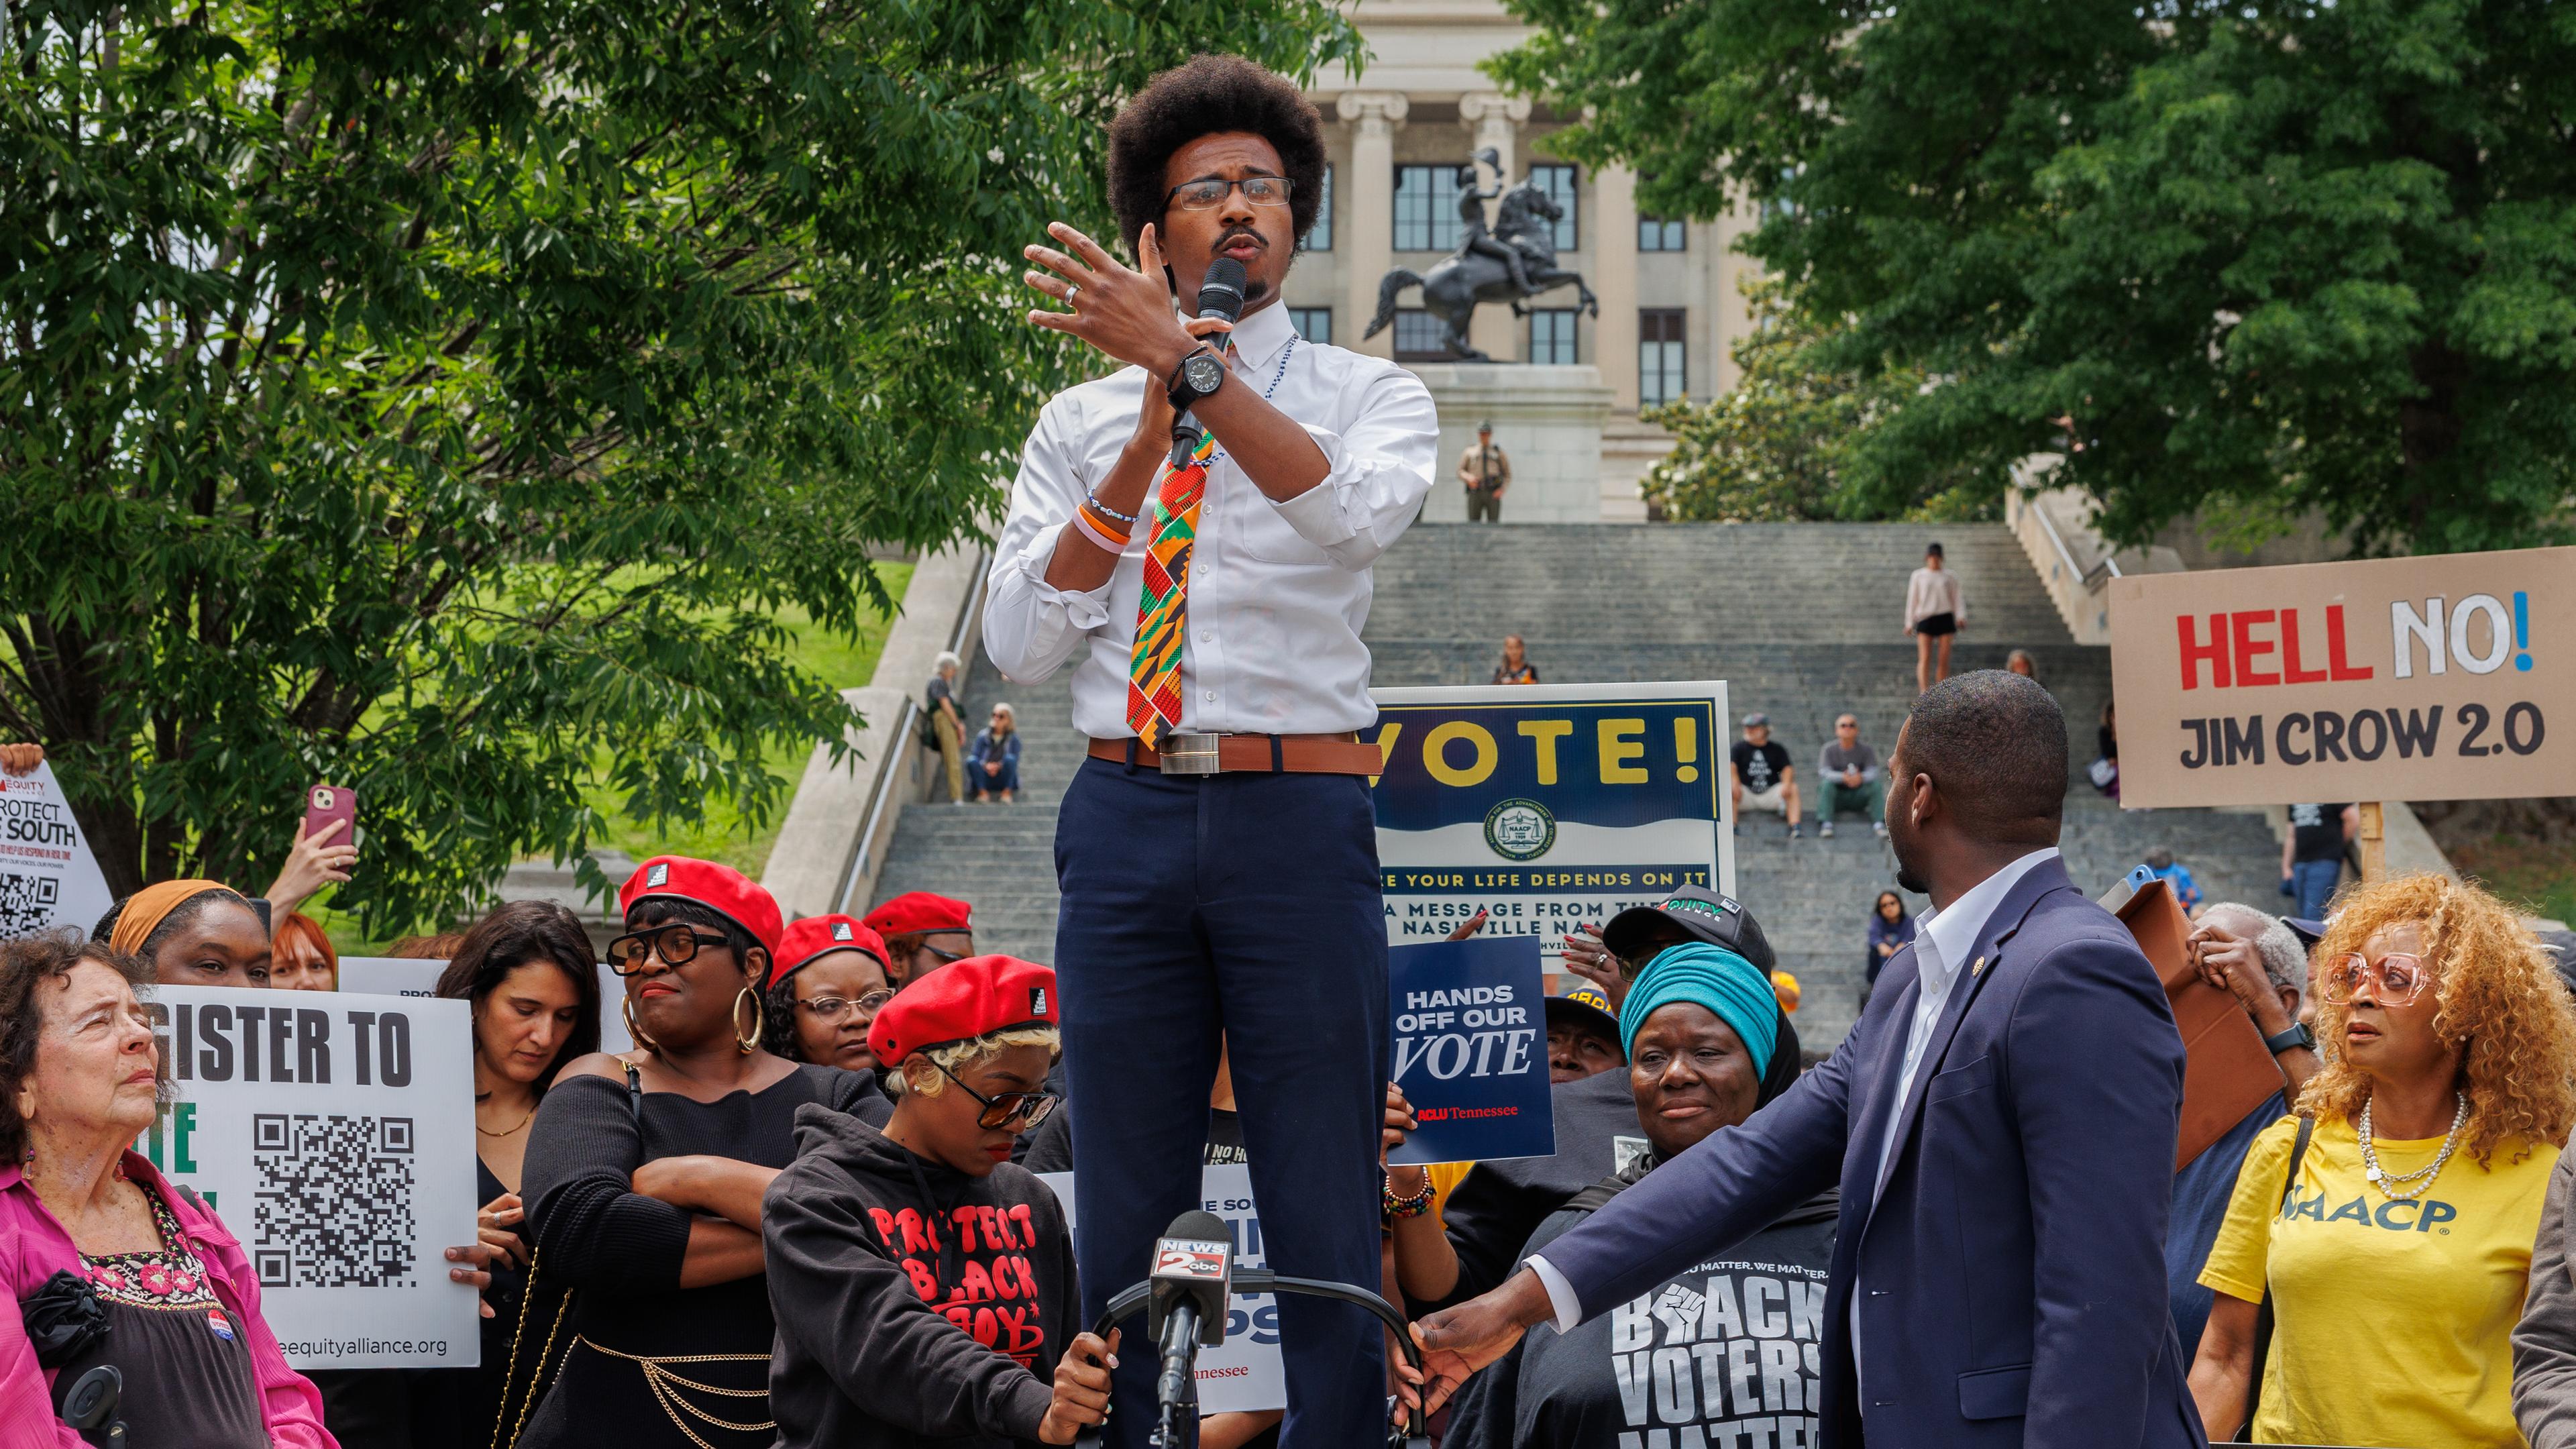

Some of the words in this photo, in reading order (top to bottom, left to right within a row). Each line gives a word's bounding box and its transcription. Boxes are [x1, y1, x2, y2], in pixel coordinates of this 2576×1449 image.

[2176, 604, 2373, 690] HELL
[2390, 591, 2533, 679] NO!
[2180, 714, 2265, 769] JIM
[2275, 704, 2443, 765] CROW
[2457, 701, 2545, 757] 2.0
[7, 780, 44, 790] EQUITY
[7, 818, 76, 847] SOUTH
[1406, 874, 1464, 887] YOUR
[1474, 874, 1520, 887] LIFE
[1531, 873, 1631, 886] DEPENDS
[1642, 872, 1673, 885] ON
[1684, 872, 1706, 885] IT
[1384, 904, 1397, 916] A
[1409, 903, 1522, 917] MESSAGE
[1536, 902, 1603, 916] FROM
[1666, 899, 1724, 915] QUITY
[1407, 985, 1514, 1010] HANDS
[1396, 1011, 1455, 1032] OFF
[1463, 1007, 1527, 1028] OUR
[347, 1011, 412, 1087] TO
[1393, 1028, 1537, 1083] VOTE
[1417, 1108, 1448, 1121] ACLU
[1449, 1106, 1519, 1120] Tennessee
[1212, 1144, 1232, 1158] NO
[1201, 1201, 1217, 1211] E
[2274, 1184, 2457, 1232] NAACP
[1162, 1242, 1226, 1253] NEWS
[1159, 1252, 1196, 1275] 2
[1189, 1261, 1220, 1271] abc
[1683, 1265, 1699, 1274] U
[1701, 1261, 1754, 1271] MATTER.
[1754, 1263, 1776, 1273] WE
[1778, 1265, 1829, 1279] MATTER.
